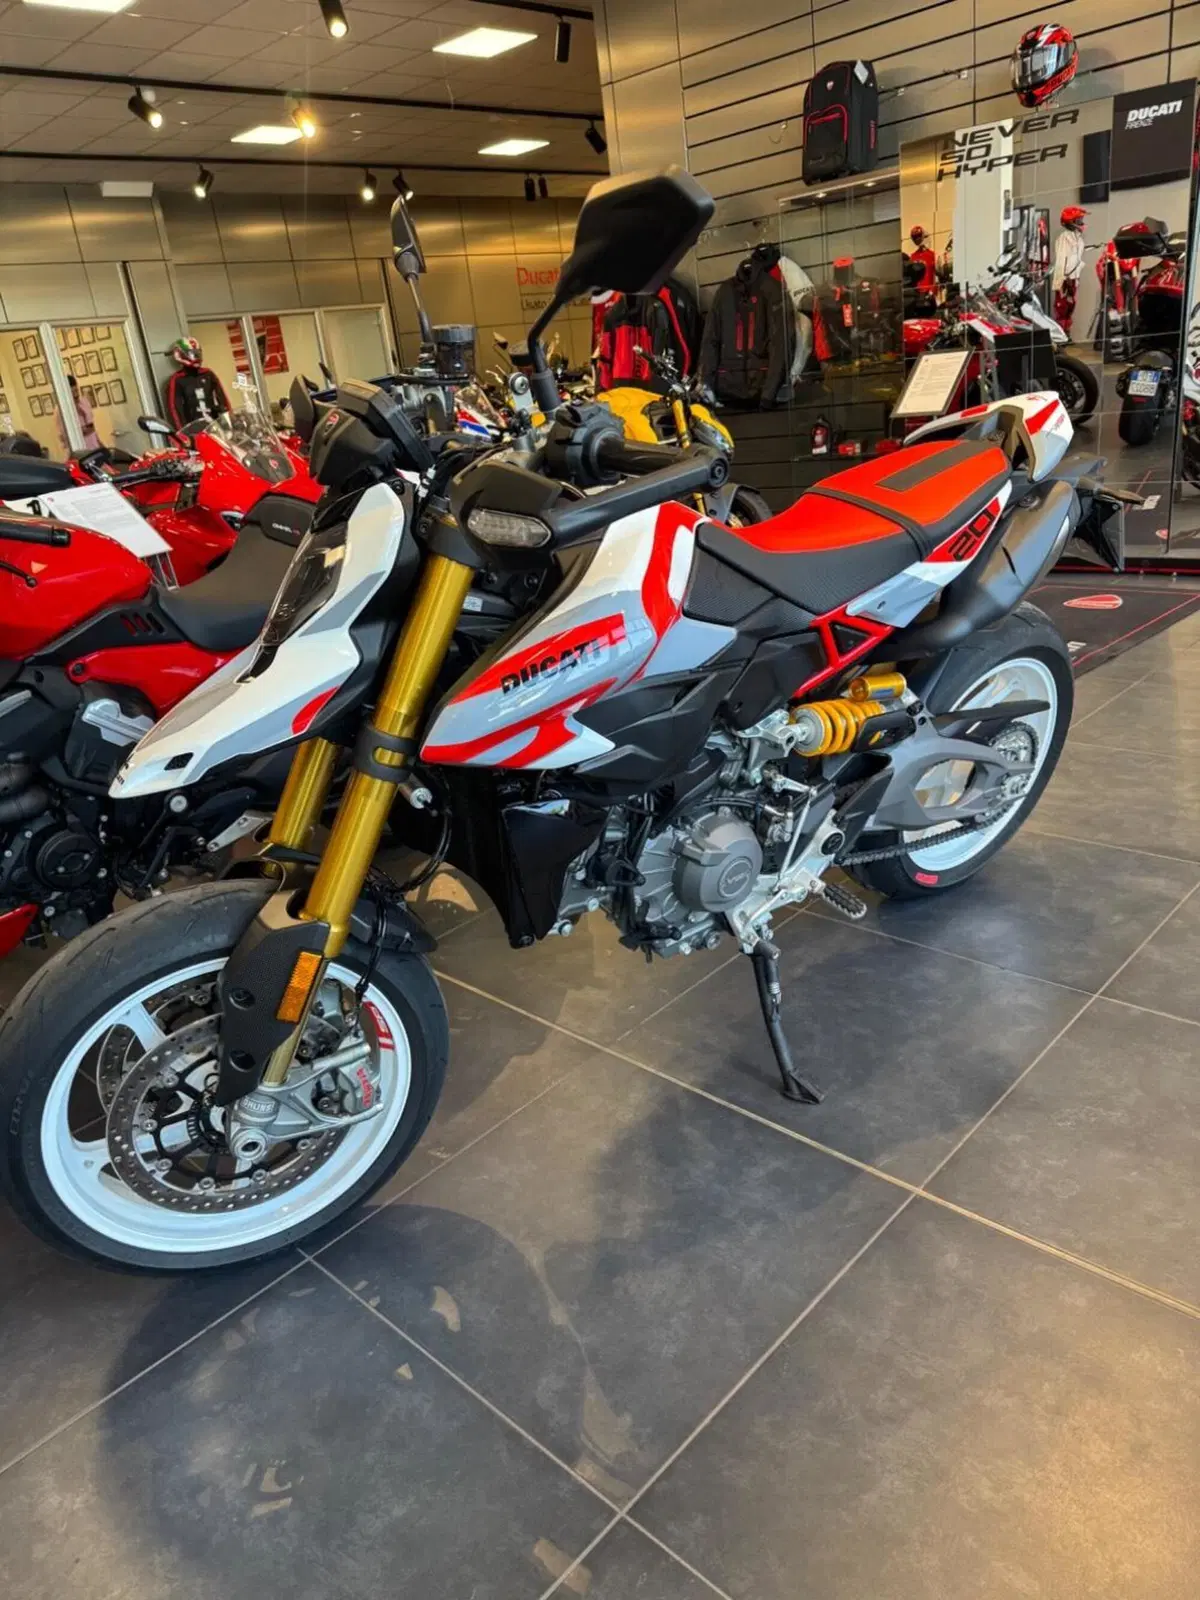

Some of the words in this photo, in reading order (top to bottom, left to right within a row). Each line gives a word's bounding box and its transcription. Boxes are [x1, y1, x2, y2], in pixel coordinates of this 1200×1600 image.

[1127, 99, 1183, 122] DUCATI
[943, 108, 1080, 150] NEVER
[936, 143, 1069, 182] HYPER
[940, 143, 992, 166] SO
[515, 267, 560, 286] Ducat
[947, 507, 996, 562] 20
